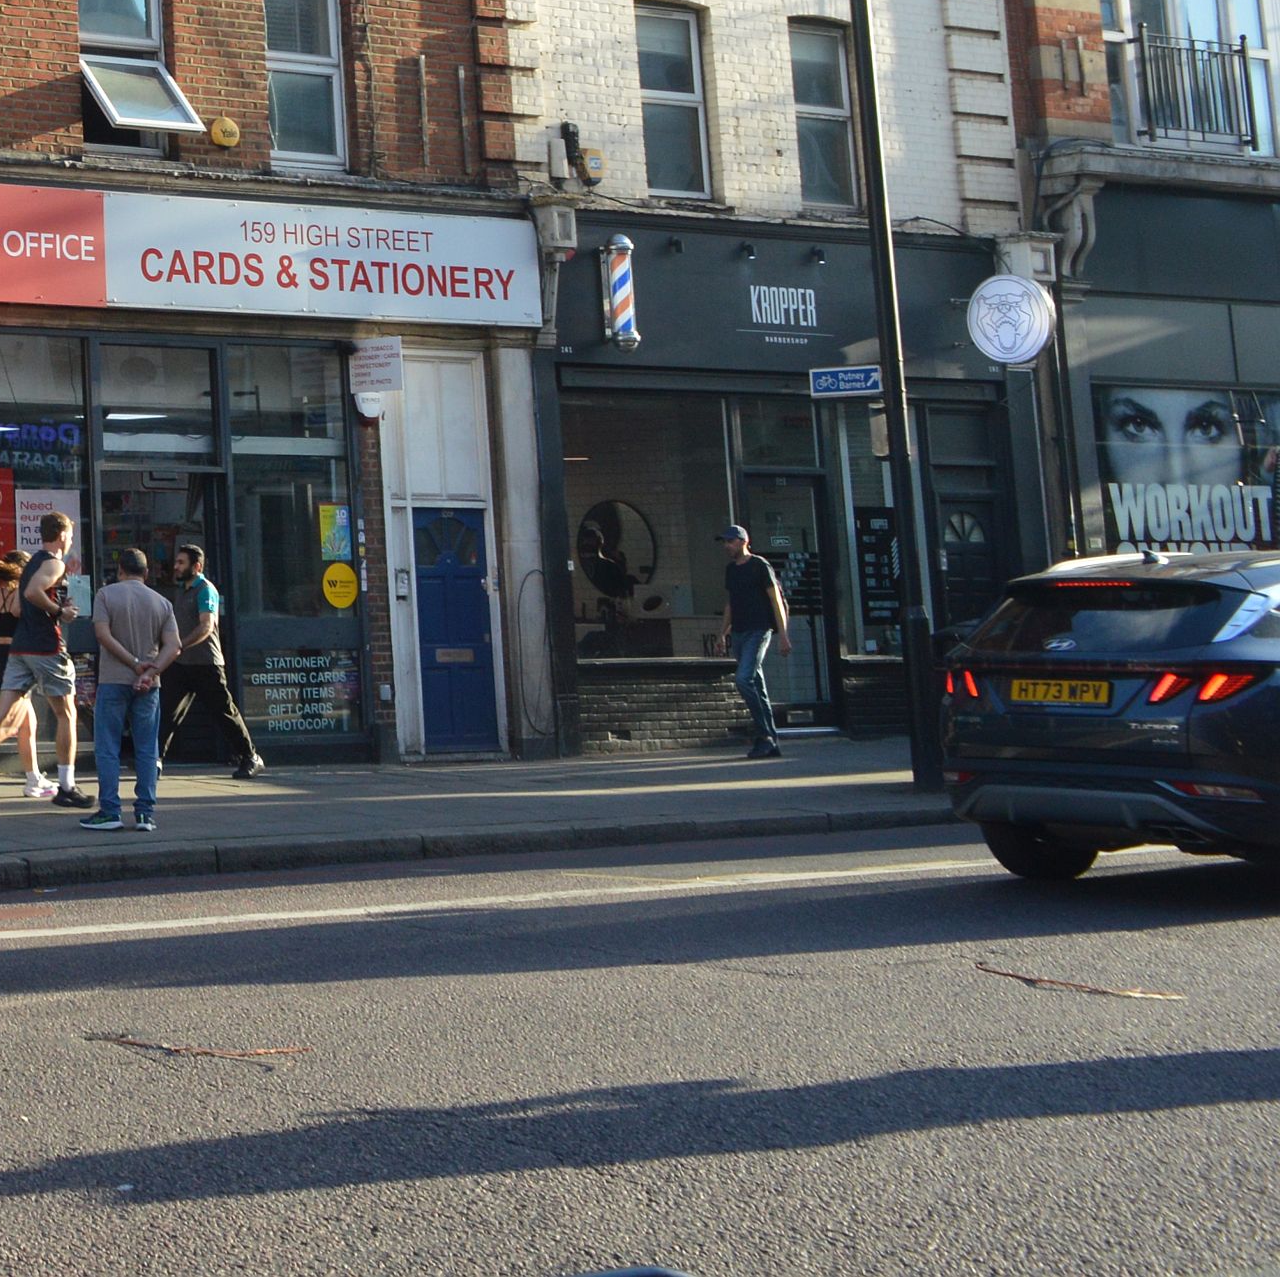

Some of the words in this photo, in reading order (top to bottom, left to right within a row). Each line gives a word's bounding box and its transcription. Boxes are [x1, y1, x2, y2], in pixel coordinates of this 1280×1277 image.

[240, 220, 276, 244] 159
[283, 222, 340, 247] HIGH
[346, 227, 434, 253] STREET
[3, 230, 96, 261] OFFICE
[140, 247, 265, 287] CARDS
[276, 255, 299, 289] &
[308, 257, 515, 301] STATIONERY
[750, 285, 817, 327] KROPPER
[838, 372, 865, 381] Putney
[840, 381, 866, 389] Barnes
[20, 501, 53, 511] Need
[1108, 482, 1273, 542] WORKOUT
[20, 514, 42, 523] eur
[336, 509, 347, 518] 10
[21, 525, 32, 533] in
[21, 537, 42, 545] hur
[265, 656, 331, 669] STATIONERY
[251, 672, 307, 684] GREETING
[309, 671, 347, 683] CARDS
[265, 688, 300, 700] PARTY
[303, 687, 336, 699] ITEMS
[1017, 682, 1062, 699] HT73
[1068, 685, 1103, 701] WPV
[269, 704, 293, 716] GIFT
[296, 703, 333, 715] CARDS
[268, 718, 336, 731] PHOTOCOPY
